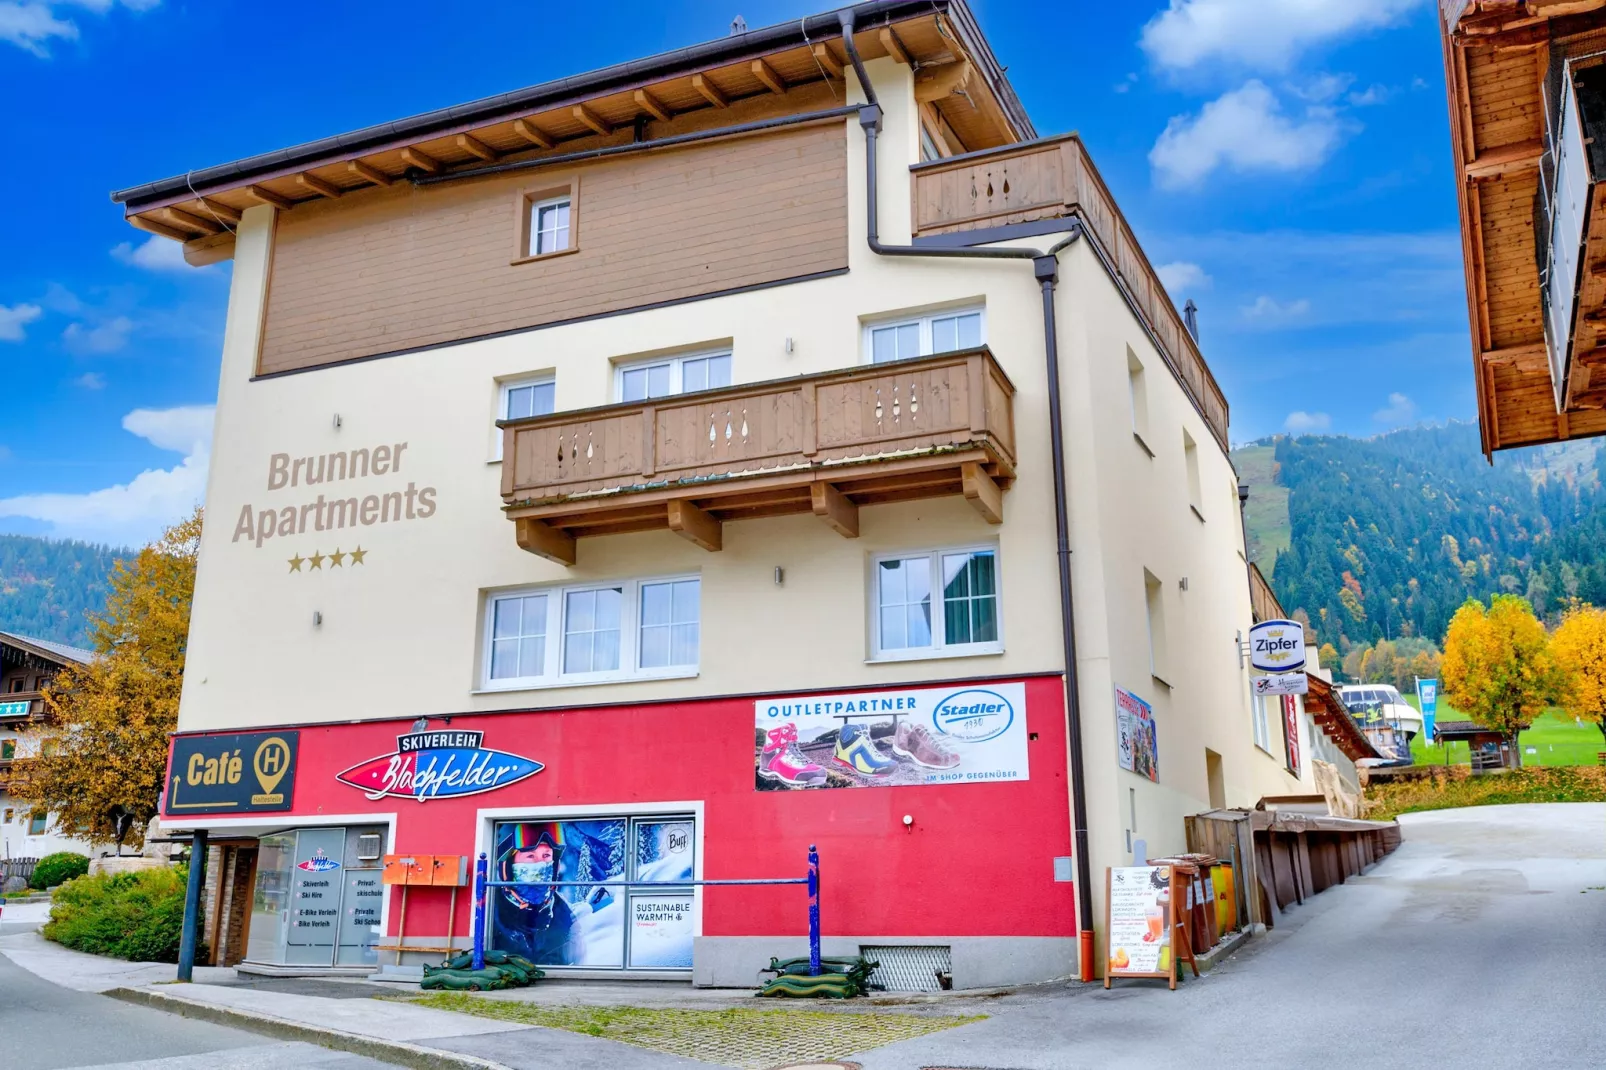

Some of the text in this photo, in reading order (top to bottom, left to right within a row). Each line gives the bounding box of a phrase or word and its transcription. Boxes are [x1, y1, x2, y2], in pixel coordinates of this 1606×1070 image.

[267, 442, 408, 491] Brunner
[231, 482, 437, 548] Apartments
[1256, 637, 1298, 654] Zipfer
[768, 697, 917, 718] OUTLETPARTNER
[940, 703, 1005, 716] Stadler
[964, 717, 983, 730] 1930
[402, 734, 477, 751] SKIVERLEIH
[187, 749, 243, 786] Café
[263, 747, 281, 773] H
[365, 752, 512, 802] Blachfelder
[967, 770, 1017, 779] GEGENÜBER
[636, 903, 690, 912] SUSTAINABLE
[636, 913, 673, 921] WARMTH
